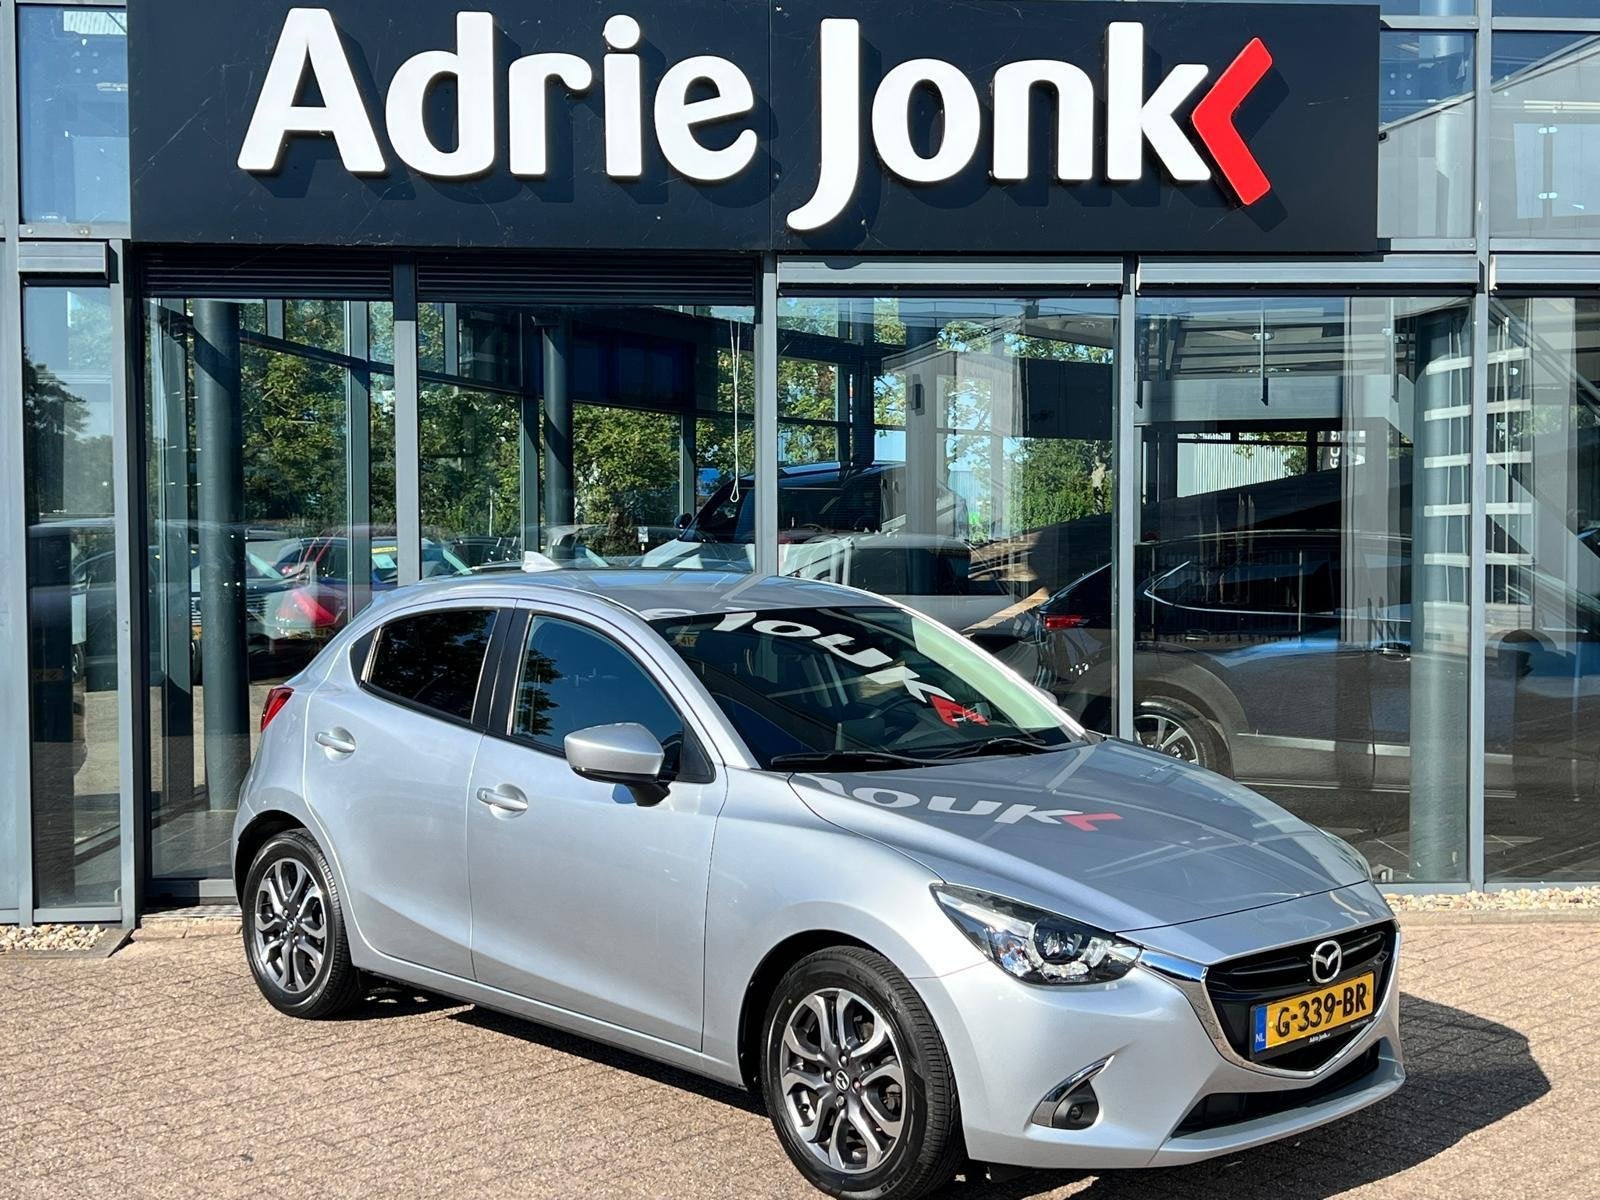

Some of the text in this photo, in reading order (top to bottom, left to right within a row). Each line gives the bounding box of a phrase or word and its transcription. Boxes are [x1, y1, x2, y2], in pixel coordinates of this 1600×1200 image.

[238, 8, 1211, 230] Adrie Jonk
[1255, 982, 1367, 1043] NL G-339-BR
